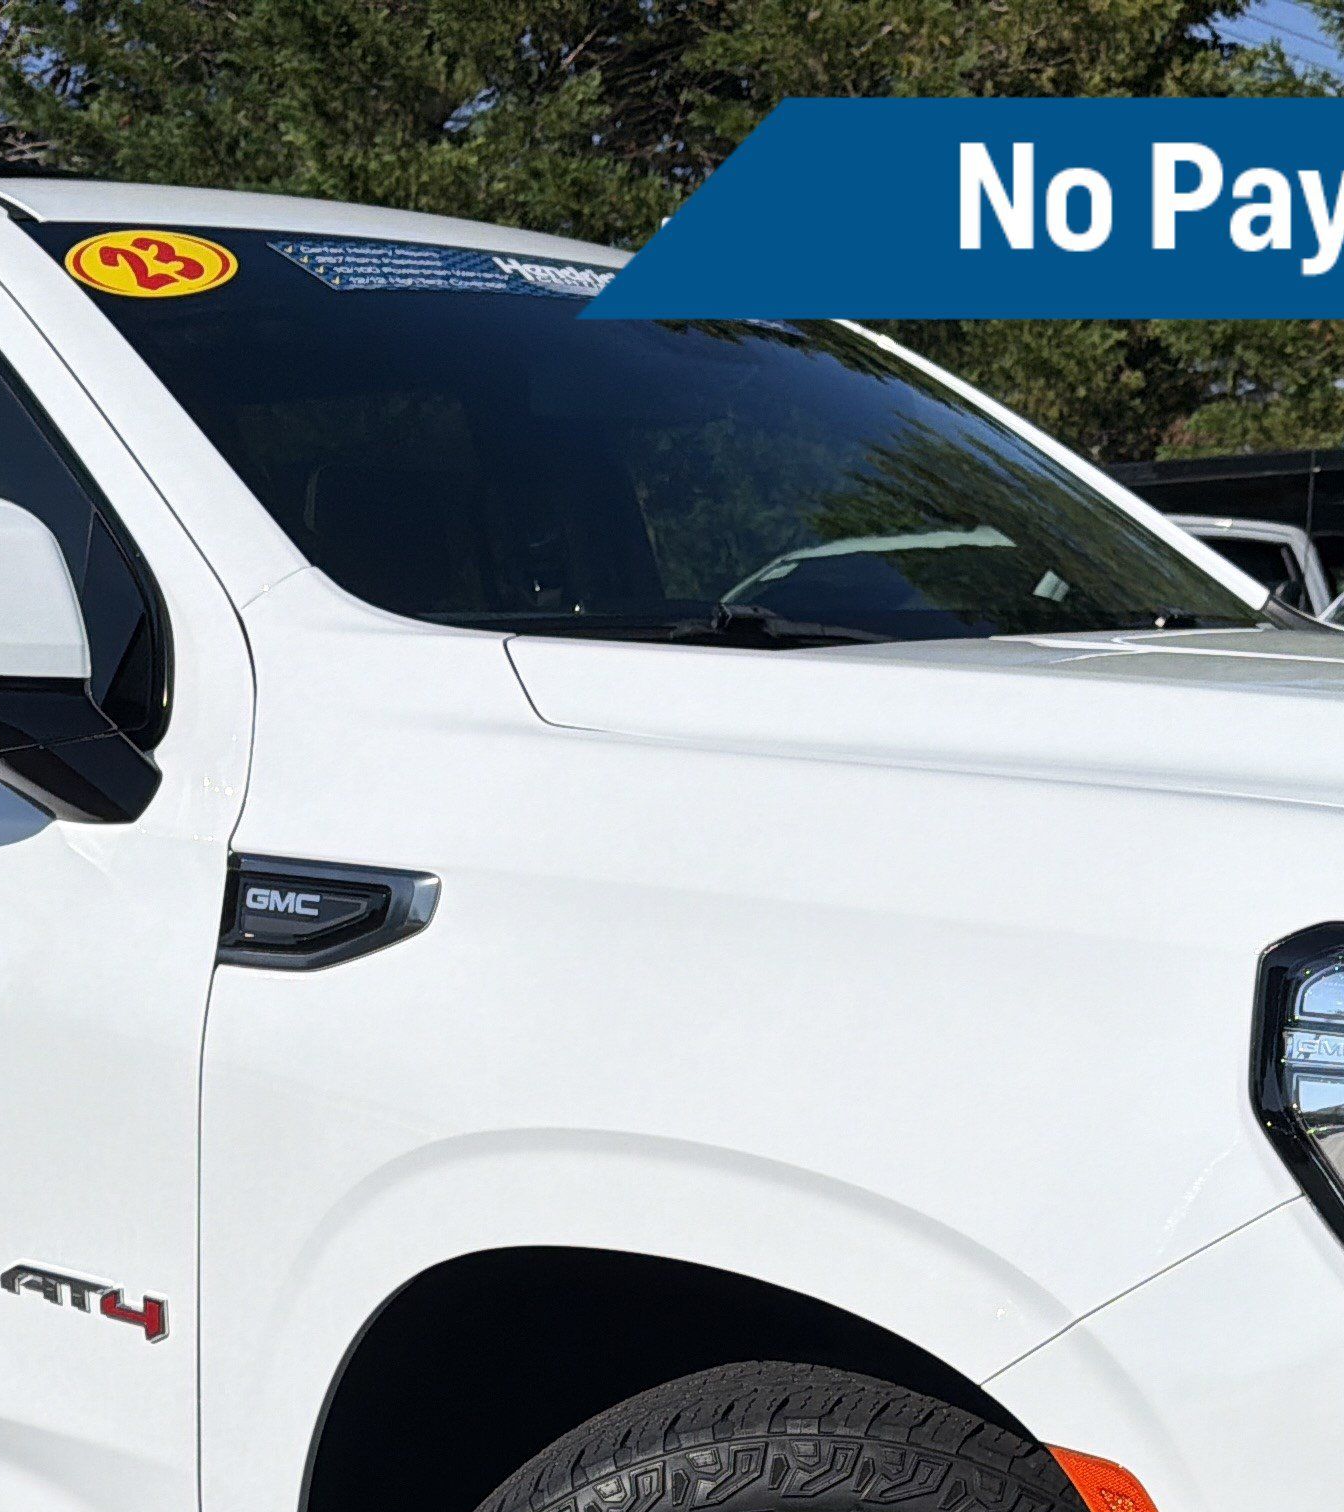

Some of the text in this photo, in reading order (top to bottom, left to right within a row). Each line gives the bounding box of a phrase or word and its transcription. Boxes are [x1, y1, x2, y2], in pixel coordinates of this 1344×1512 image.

[99, 237, 205, 291] 23
[245, 887, 321, 916] GMC
[0, 1260, 171, 1345] AT4
